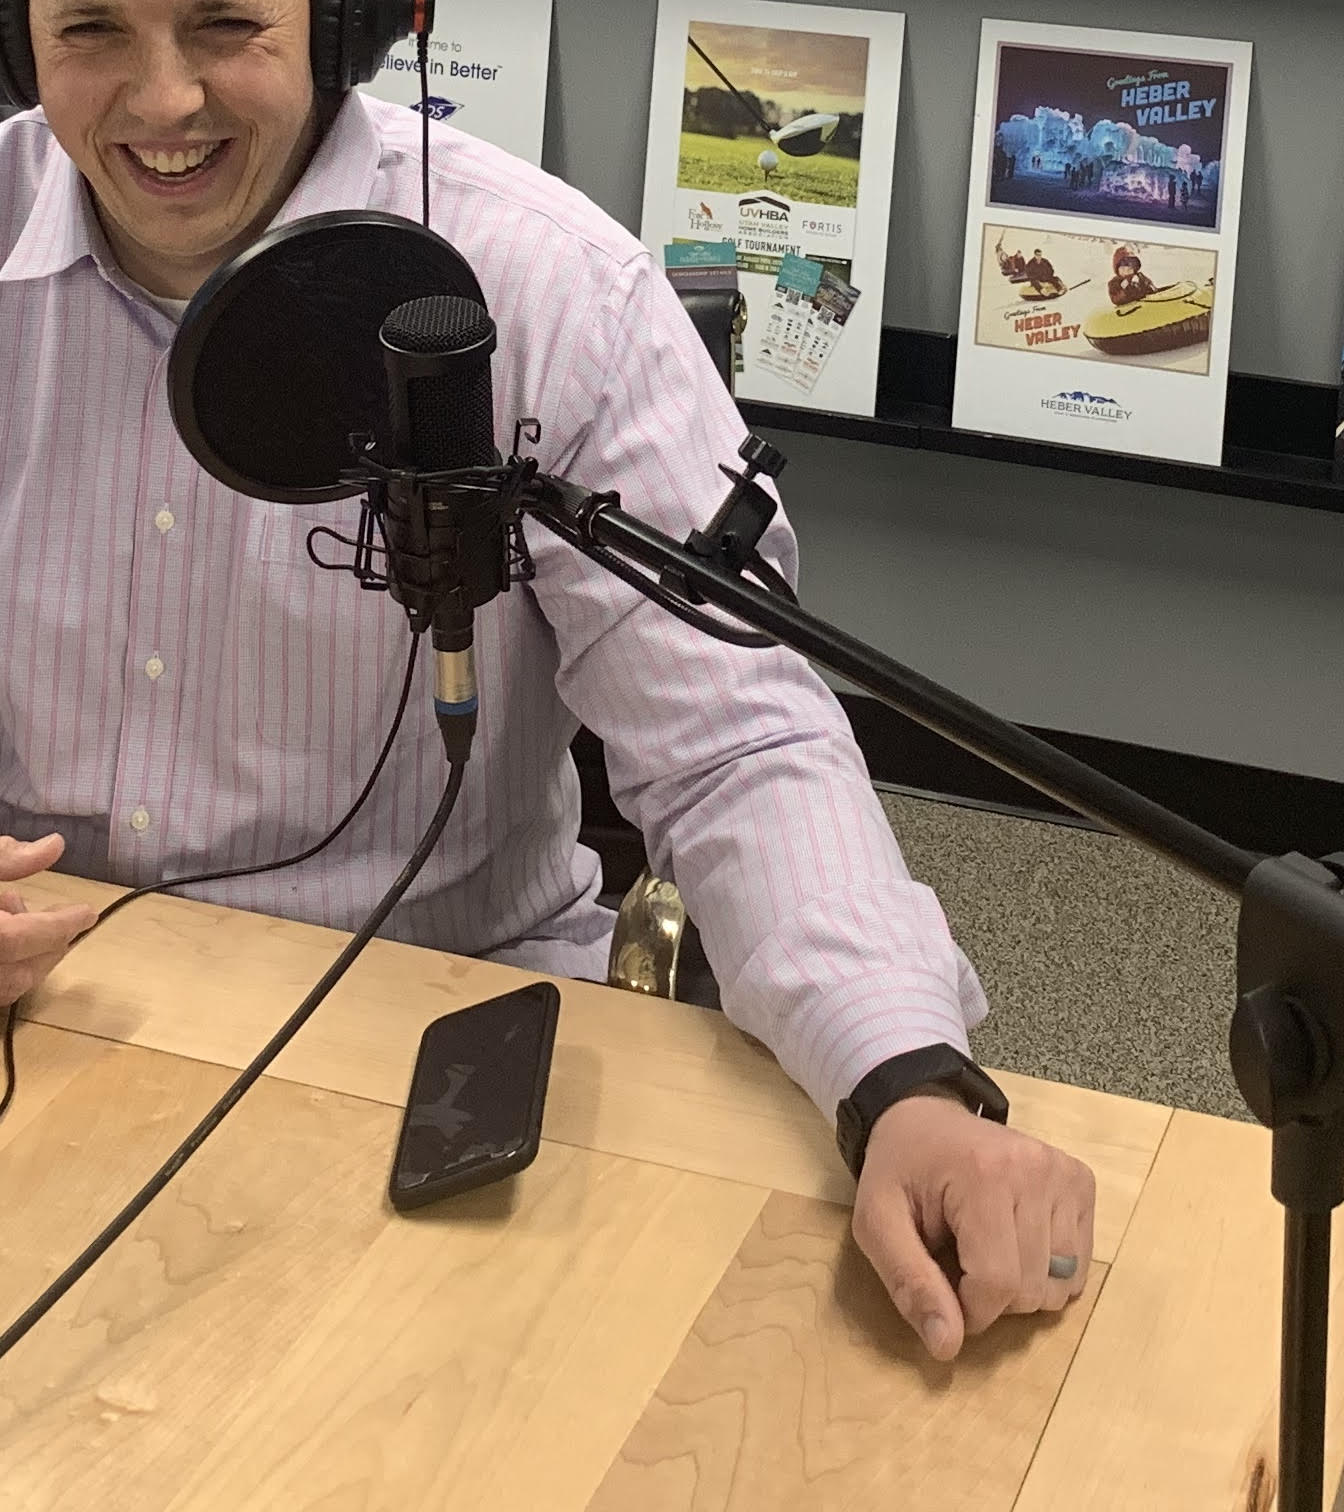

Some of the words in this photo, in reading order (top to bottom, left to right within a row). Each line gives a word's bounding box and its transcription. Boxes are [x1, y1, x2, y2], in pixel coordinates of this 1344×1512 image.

[452, 40, 462, 52] to
[430, 59, 444, 75] in
[450, 61, 498, 80] Better
[1107, 74, 1146, 89] Greetings
[1147, 69, 1170, 81] From
[1121, 80, 1190, 108] HEBER
[1136, 98, 1217, 127] VALLEY
[740, 207, 789, 222] UVHBA
[745, 239, 801, 256] TOURNAMENT
[1015, 312, 1061, 332] HEBER
[1026, 324, 1080, 346] VALLEY
[1041, 399, 1081, 413] HEBER
[1084, 405, 1132, 420] VALLEY
